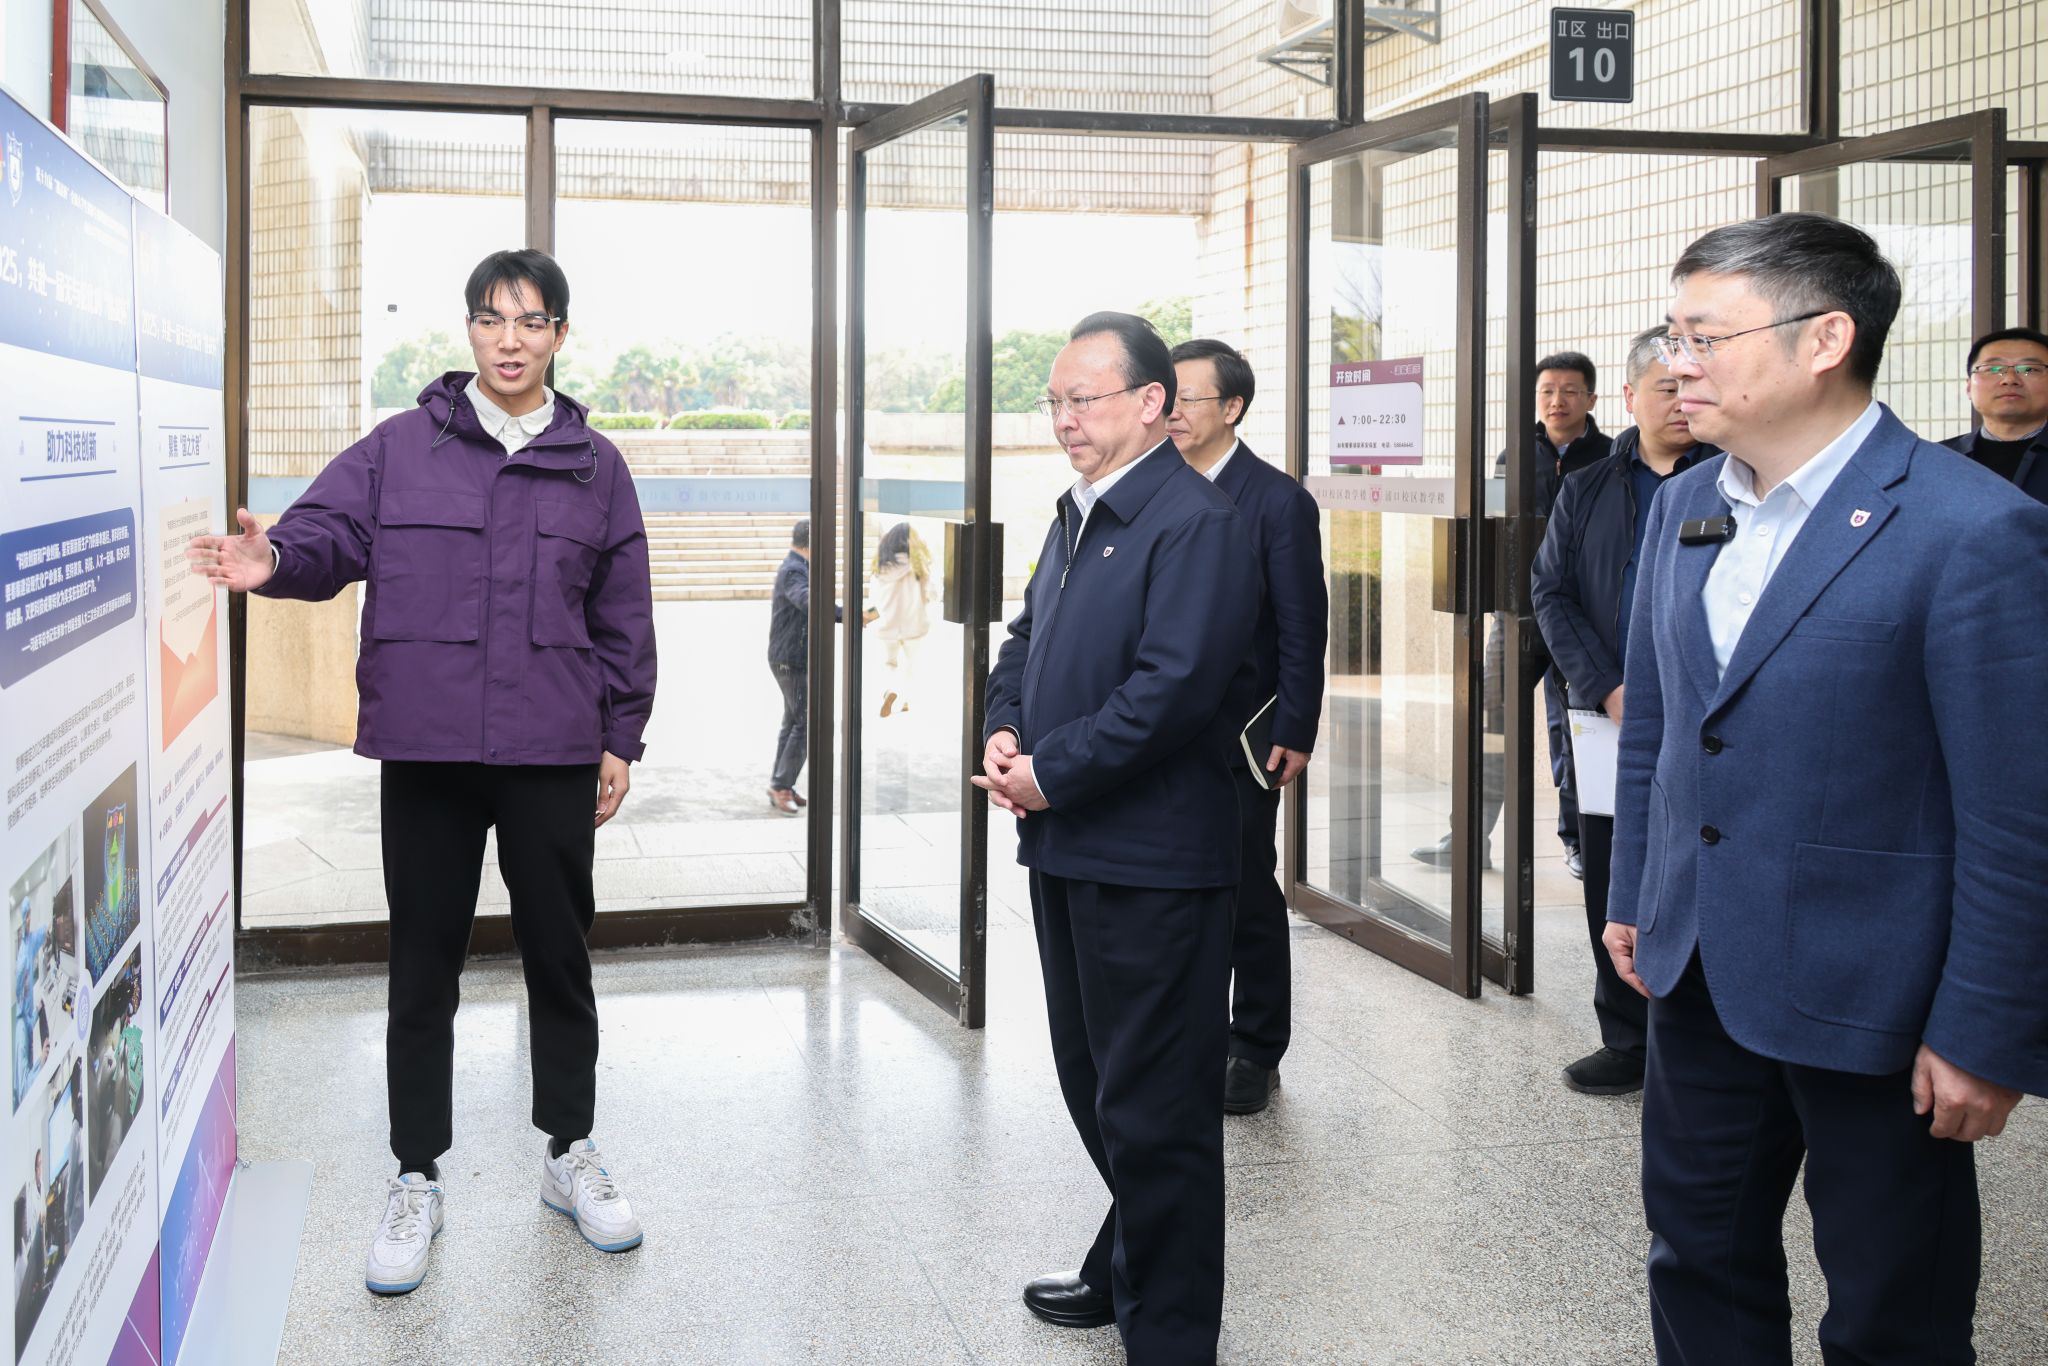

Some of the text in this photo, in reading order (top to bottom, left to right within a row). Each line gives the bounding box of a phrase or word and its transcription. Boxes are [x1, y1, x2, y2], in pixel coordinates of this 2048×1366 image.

[1597, 20, 1629, 41] 出口
[1568, 46, 1616, 83] 10
[1335, 369, 1371, 384] 开放时间
[46, 430, 97, 463] 助力科技创新
